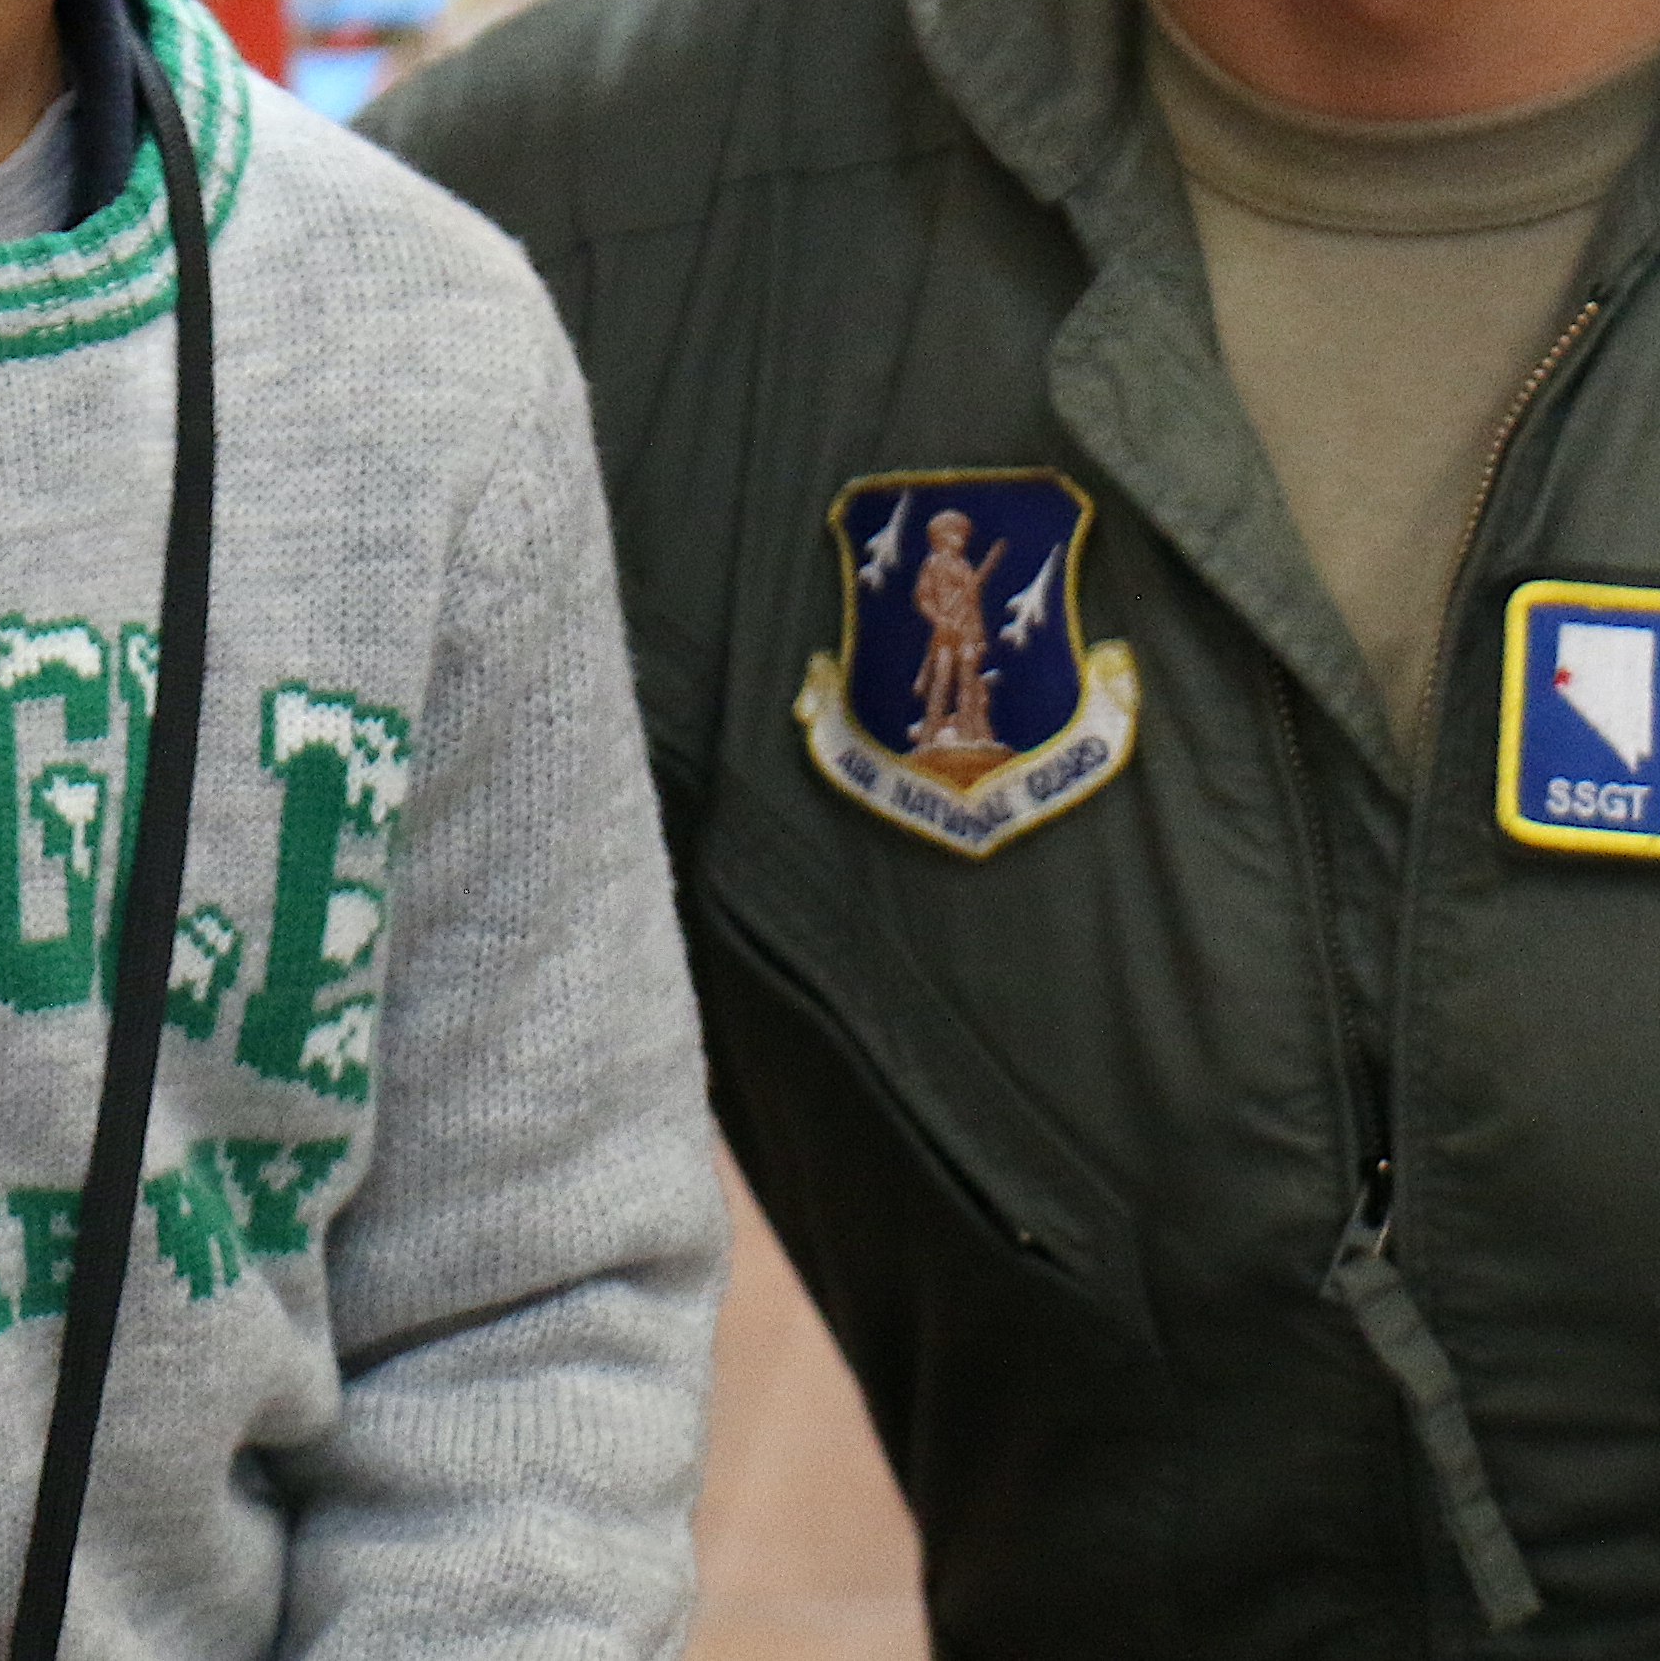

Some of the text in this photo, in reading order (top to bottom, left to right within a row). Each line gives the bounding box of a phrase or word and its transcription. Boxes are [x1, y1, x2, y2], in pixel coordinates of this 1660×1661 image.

[837, 736, 1110, 842] AIR NATIONAL GUARD
[1545, 776, 1651, 822] SSGT
